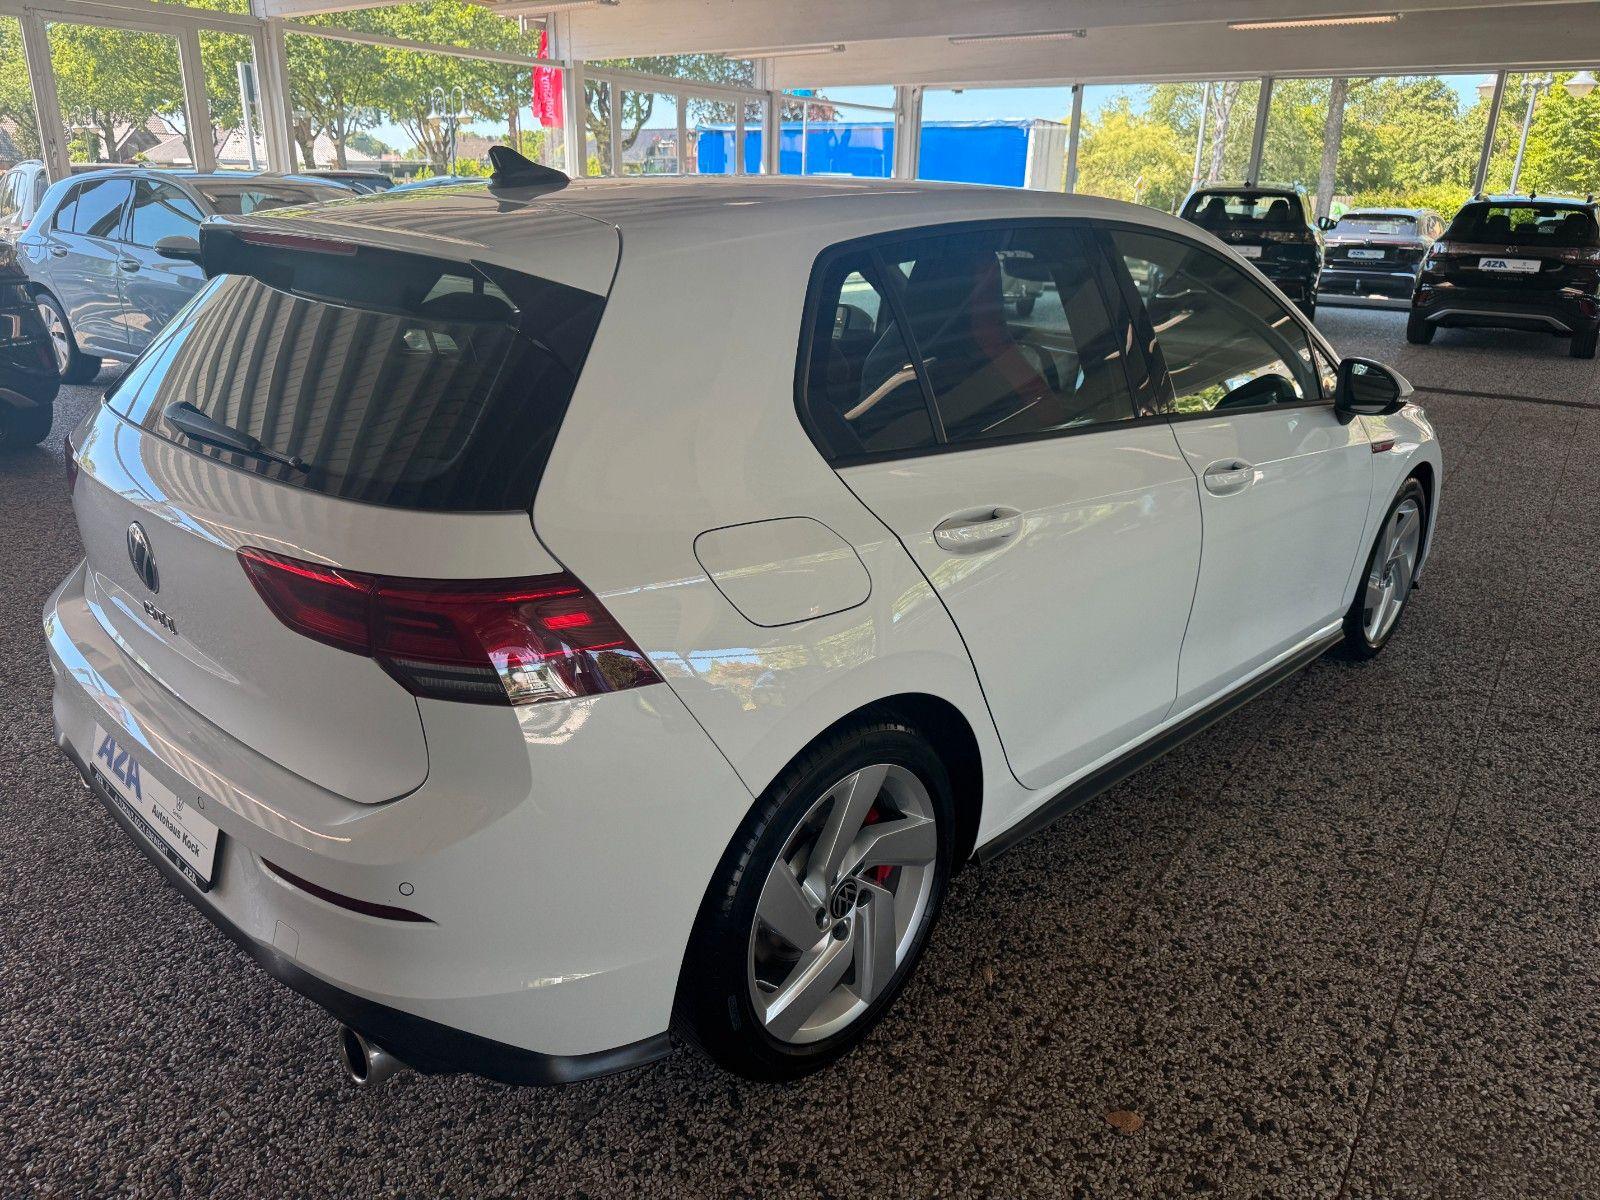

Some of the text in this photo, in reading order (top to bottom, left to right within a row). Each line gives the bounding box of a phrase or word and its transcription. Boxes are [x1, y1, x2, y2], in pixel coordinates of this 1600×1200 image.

[1481, 260, 1508, 269] AZA
[96, 734, 142, 802] AZA
[151, 804, 200, 858] Autohaus Kock
